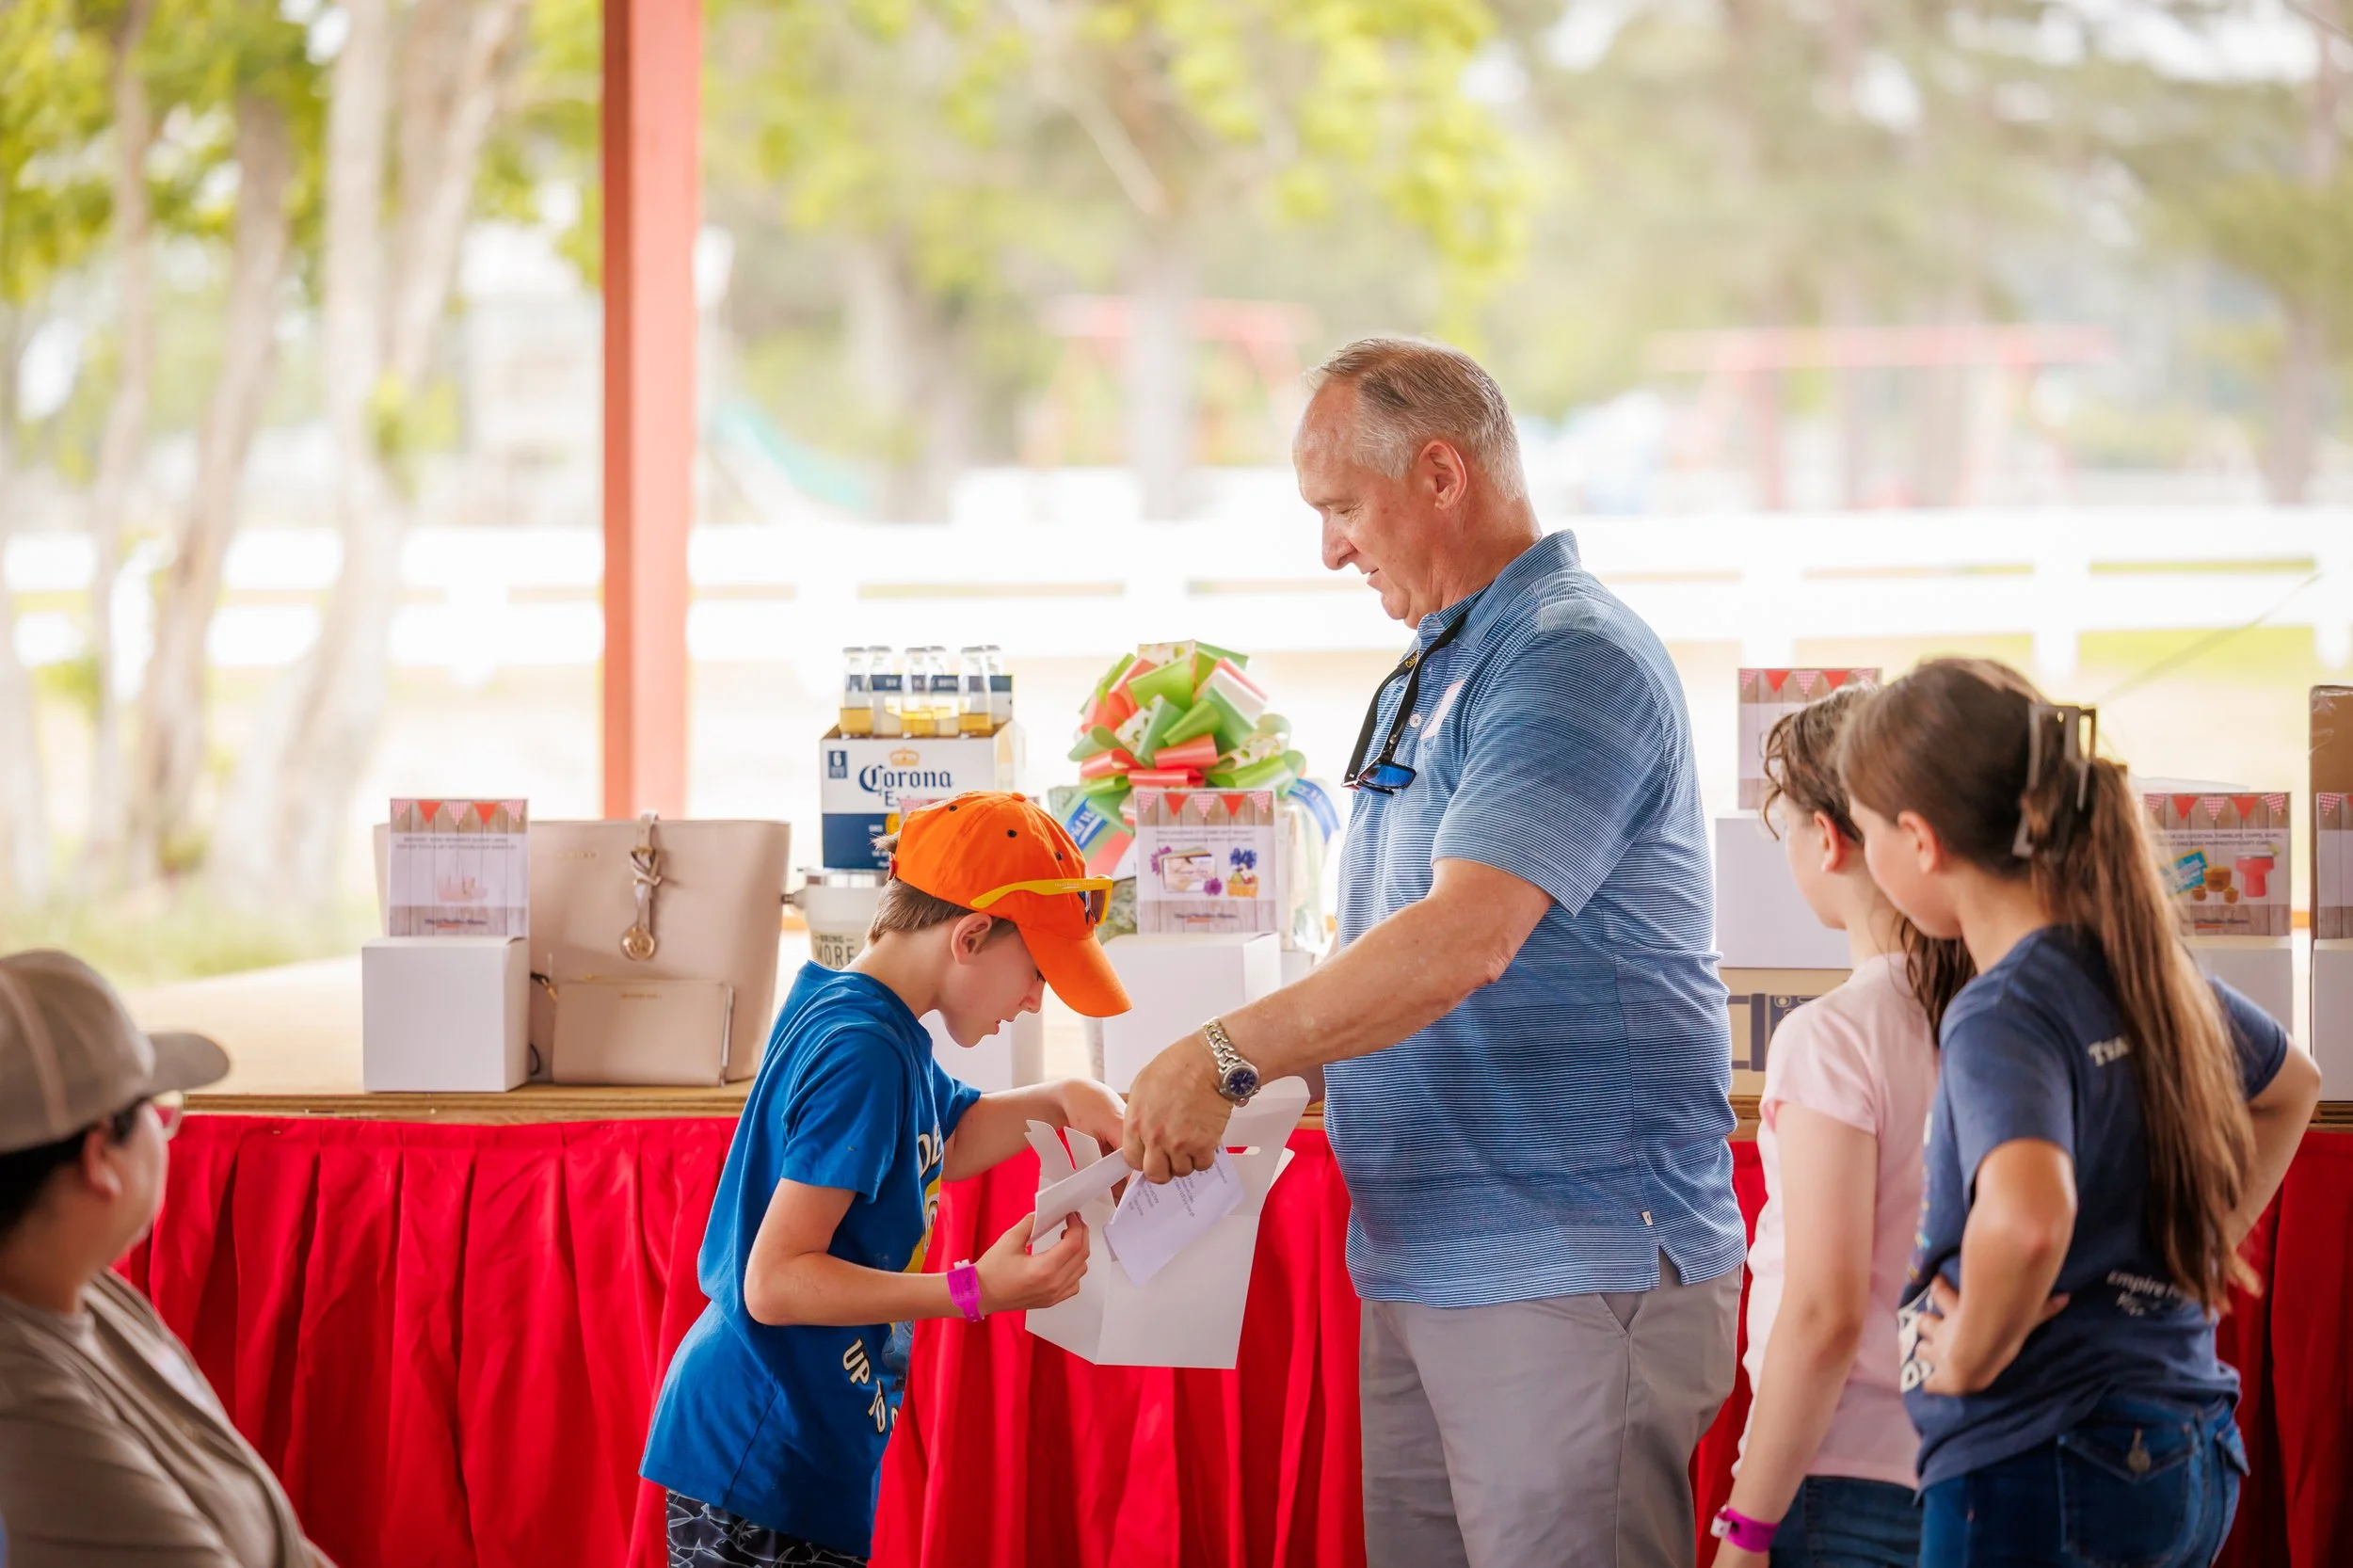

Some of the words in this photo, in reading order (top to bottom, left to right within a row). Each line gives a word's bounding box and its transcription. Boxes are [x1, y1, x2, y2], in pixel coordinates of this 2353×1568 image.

[833, 752, 842, 767] 6
[858, 765, 952, 796] Corona
[843, 1338, 870, 1384] UP
